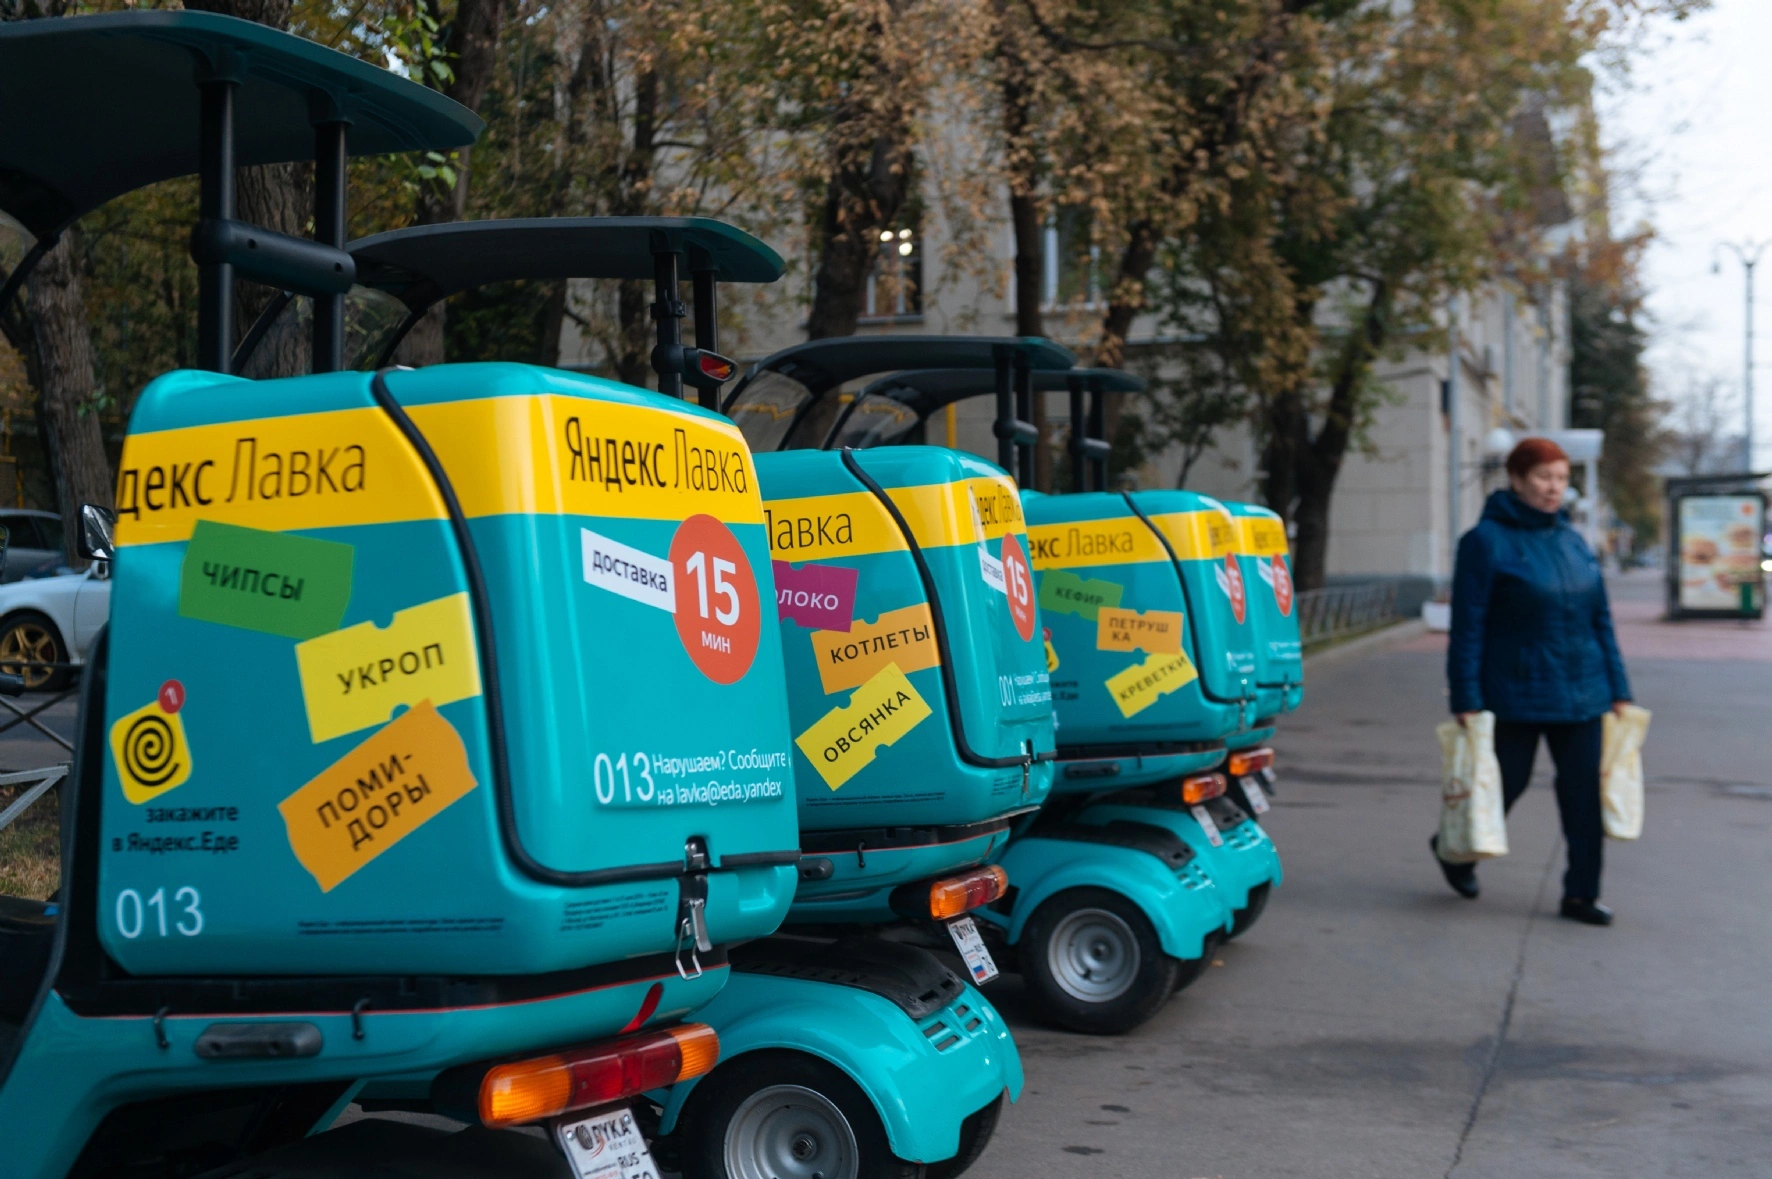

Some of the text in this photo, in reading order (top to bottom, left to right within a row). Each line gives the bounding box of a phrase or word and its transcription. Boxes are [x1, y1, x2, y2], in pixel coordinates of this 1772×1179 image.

[225, 437, 367, 503] Лавка
[565, 416, 748, 493] Яндекс Лавка
[1066, 528, 1134, 557] Лавка
[202, 561, 305, 601] ЧИПСЫ
[592, 550, 668, 593] доставка
[686, 551, 740, 626] 15
[1006, 555, 1028, 606] 15
[775, 590, 839, 611] локо
[1055, 587, 1104, 605] КЕФИР
[830, 625, 931, 664] КОТЛЕТЫ
[1109, 617, 1169, 633] ПЕТРУШ
[1111, 632, 1131, 643] КА
[337, 643, 445, 695] УКРОП
[1119, 656, 1188, 702] КРЕВЕТКИ
[164, 687, 178, 705] 1
[823, 691, 911, 763] ОВСЯНКА
[593, 752, 655, 804] 013
[652, 748, 786, 777] Нарушаем? Сообщите
[316, 754, 413, 828] ПОМИ-
[657, 789, 674, 805] на
[675, 777, 782, 806] lavka@eda.yandex
[145, 806, 239, 823] закажите
[346, 774, 432, 852] ДОРЫ
[112, 830, 240, 854] в Яндекс.Еде
[115, 886, 205, 938] 013
[617, 1152, 640, 1168] RUS
